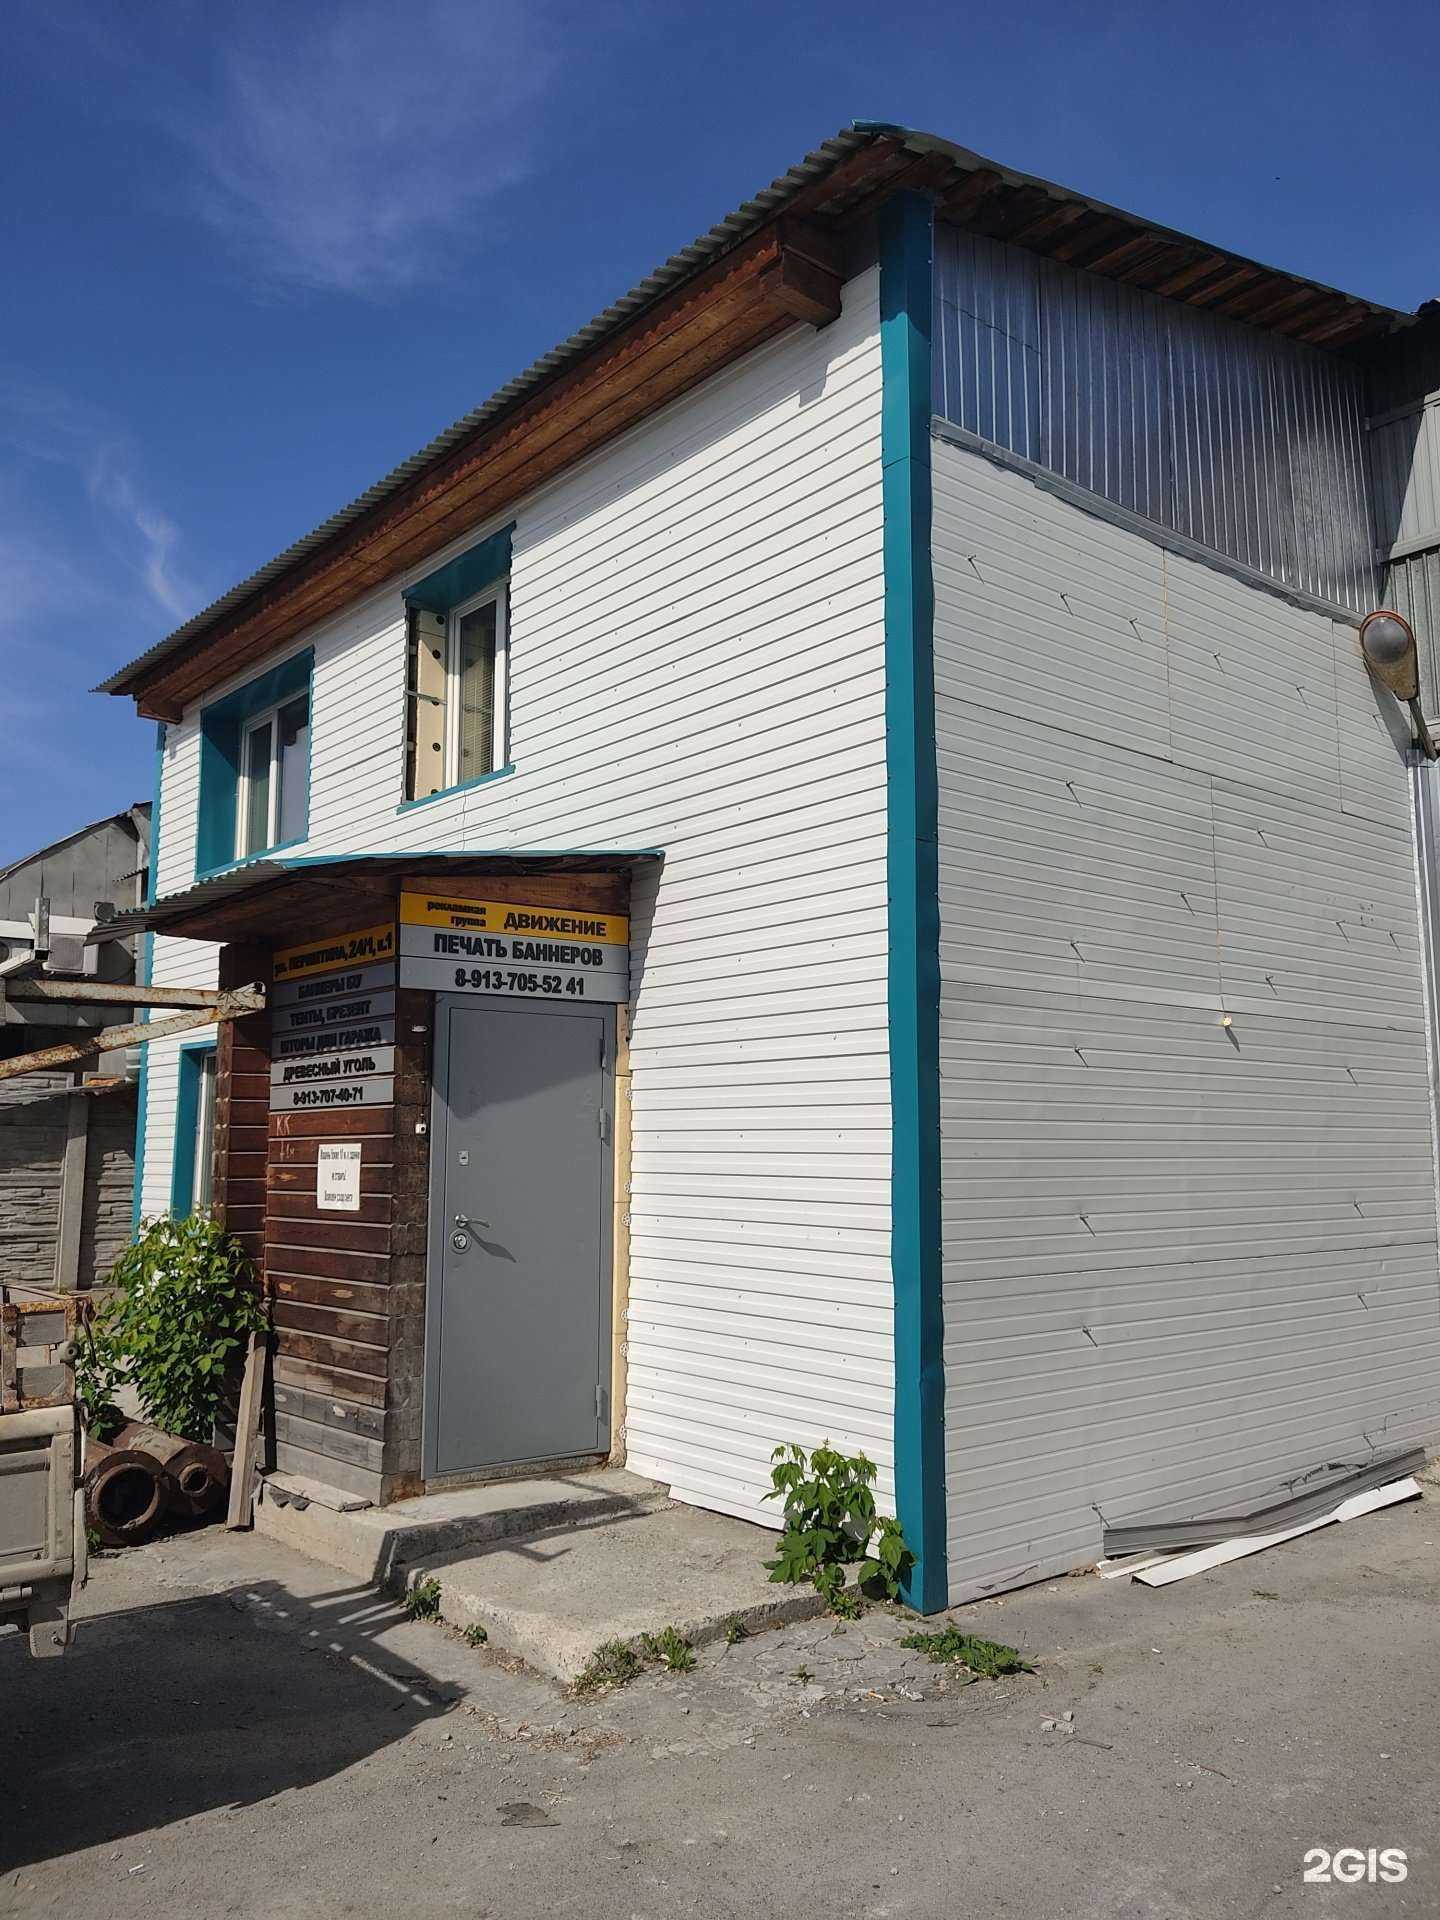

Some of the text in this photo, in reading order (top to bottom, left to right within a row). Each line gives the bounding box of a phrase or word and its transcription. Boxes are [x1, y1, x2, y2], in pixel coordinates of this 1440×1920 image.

[451, 915, 486, 928] группа
[504, 912, 607, 937] ДВИЖЕНИЕ
[434, 933, 603, 966] ПЕЧАТЬ БАННЕРОВ
[455, 968, 585, 996] 8-913-705-52 41
[283, 1056, 376, 1082] ДРЕВЕСНЫЙ УГОЛЬ
